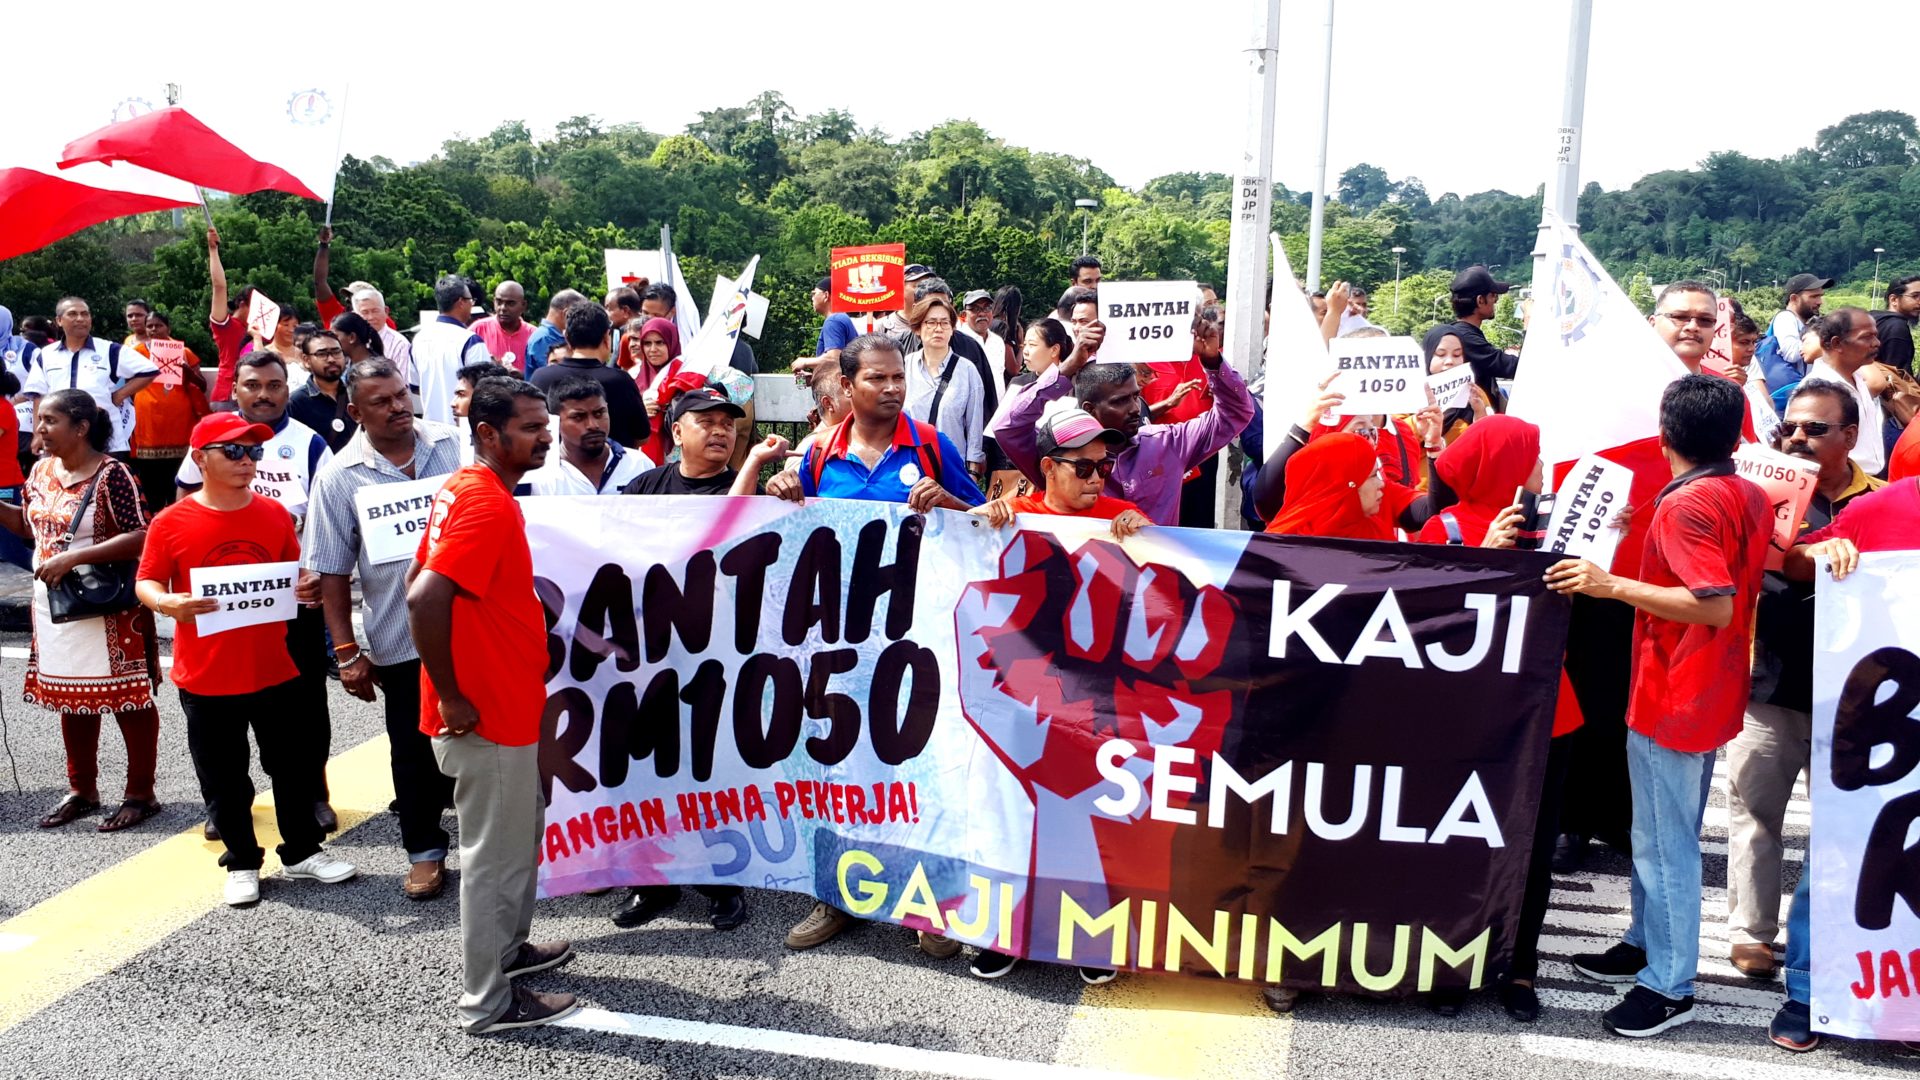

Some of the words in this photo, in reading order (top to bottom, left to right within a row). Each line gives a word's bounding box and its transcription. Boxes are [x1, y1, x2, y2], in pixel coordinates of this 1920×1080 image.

[1561, 136, 1571, 144] 13
[1558, 146, 1571, 154] JP
[1243, 188, 1257, 198] D4
[1242, 201, 1257, 211] JP
[1242, 213, 1255, 221] FP1
[832, 256, 859, 270] TIADA
[860, 253, 904, 266] SEKSISME
[1108, 301, 1190, 318] BANTAH
[1129, 325, 1174, 340] 1050
[1338, 355, 1420, 370] BANTAH
[1360, 379, 1406, 393] 1050
[255, 470, 292, 482] TAH
[247, 484, 281, 498] 050
[1551, 465, 1605, 554] BANTAH
[1583, 491, 1614, 543] 1050
[202, 577, 292, 597] BANTAH
[226, 597, 275, 611] 1050
[1268, 579, 1530, 674] KAJI
[536, 640, 941, 808] RM1050
[1092, 737, 1506, 849] SEMULA
[676, 783, 767, 832] HINA
[774, 780, 920, 824] PEKERJA!
[836, 848, 1014, 952] GAJI
[1056, 889, 1492, 993] MINIMUM
[1850, 948, 1920, 999] JA
